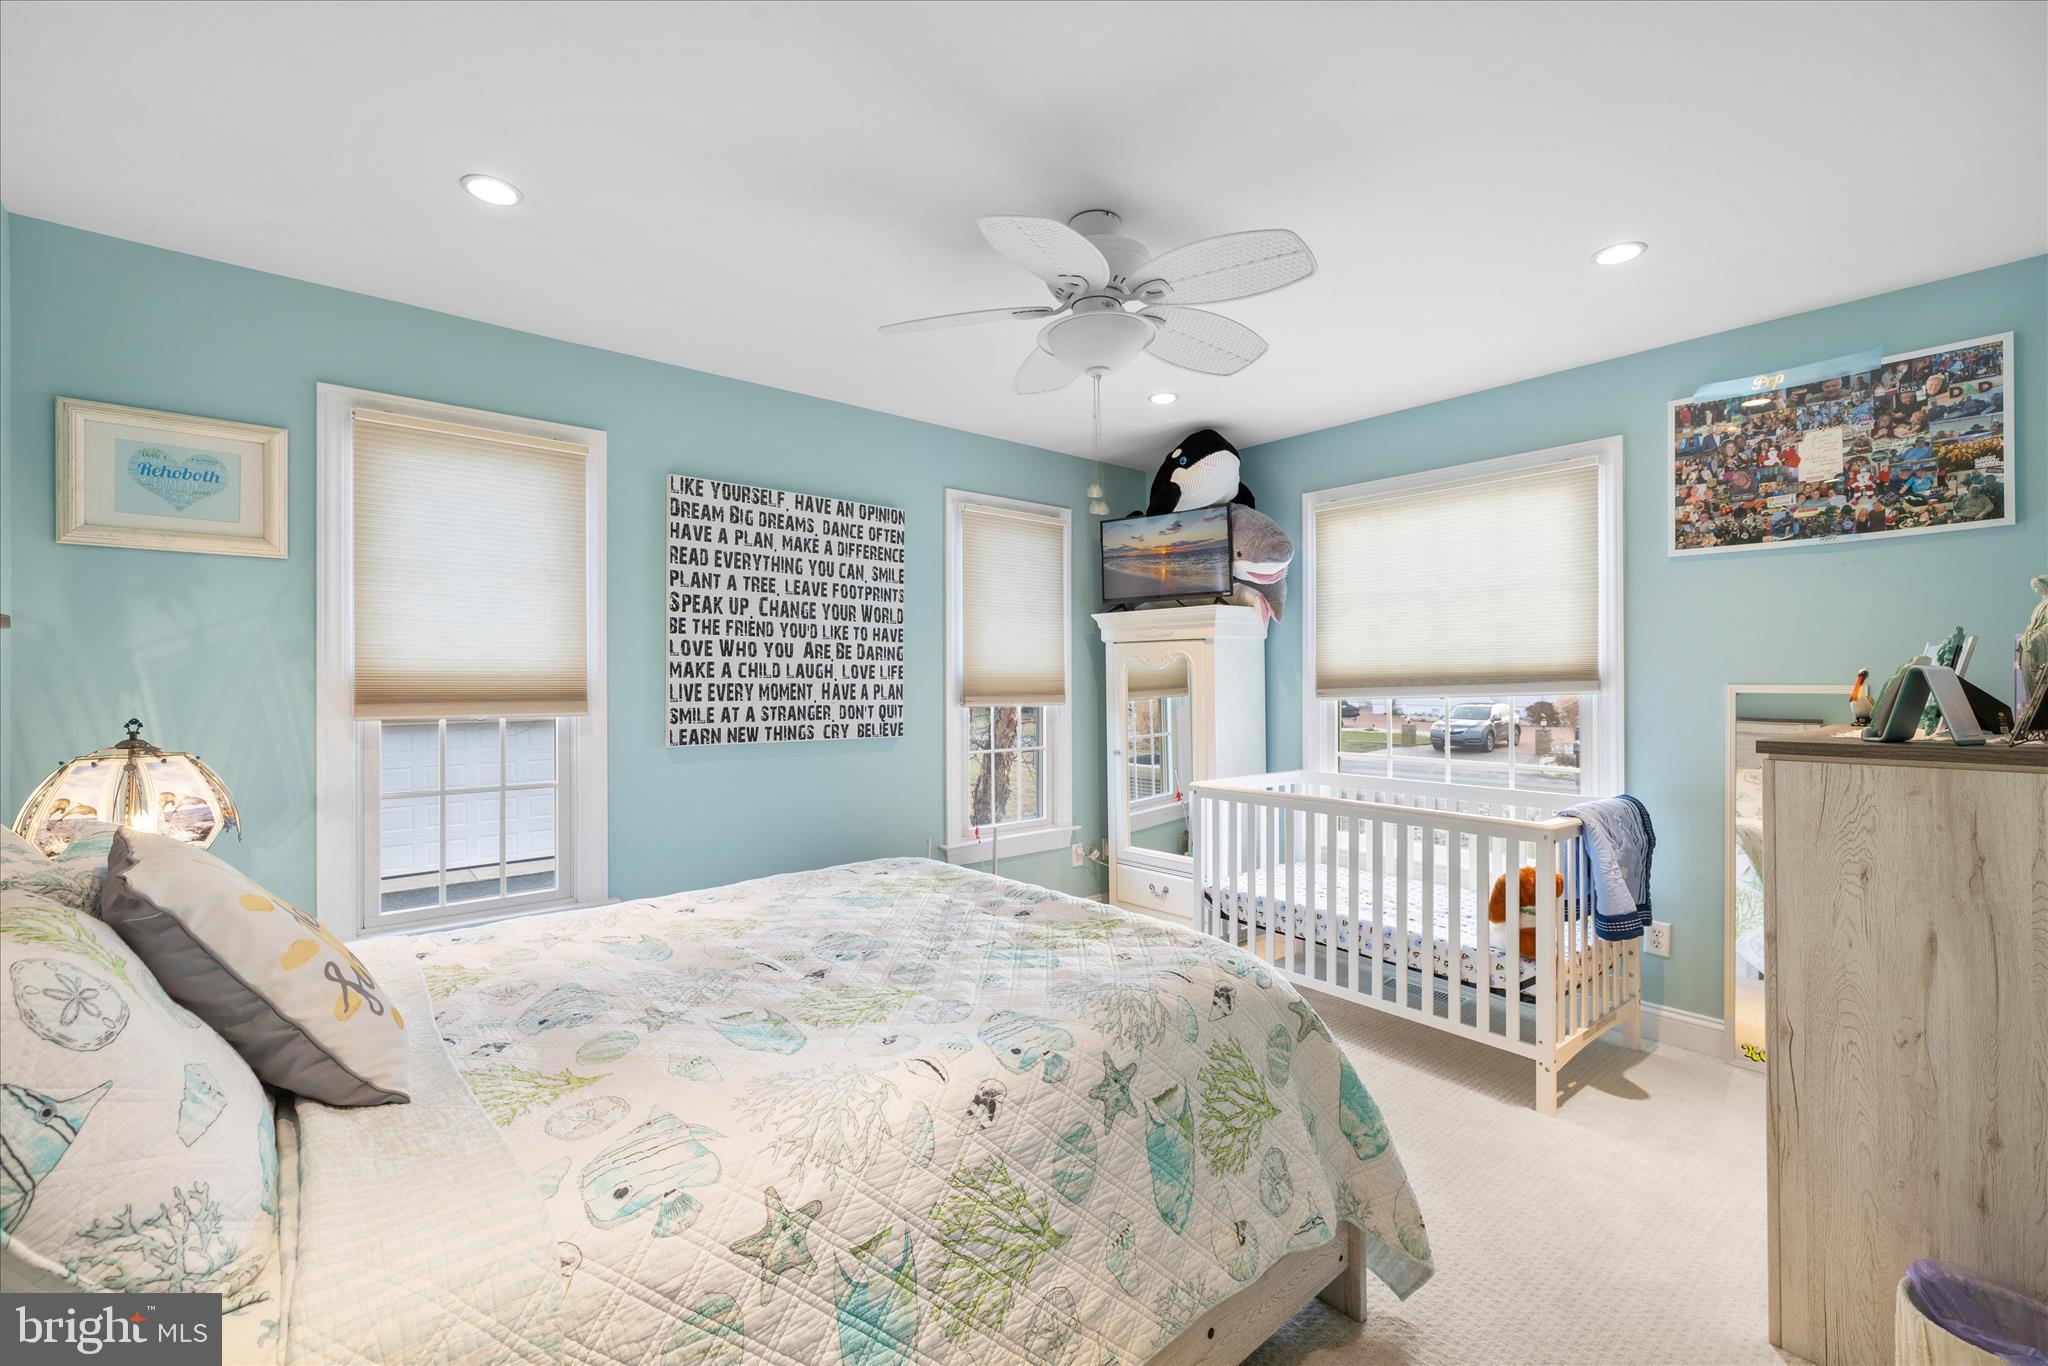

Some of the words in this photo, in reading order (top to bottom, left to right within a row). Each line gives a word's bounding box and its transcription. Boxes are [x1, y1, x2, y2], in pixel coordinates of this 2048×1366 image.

[1950, 381, 1993, 398] DAD
[138, 462, 220, 483] Rehoboth
[670, 476, 703, 496] LIKE
[795, 495, 831, 514] HAVE
[836, 501, 854, 518] AN
[859, 505, 905, 525] OPINION
[670, 497, 723, 522] DREAM
[730, 506, 753, 526] BIG
[823, 520, 863, 540] DANCE
[869, 527, 904, 544] OFTEN
[670, 522, 712, 542] HAVE
[718, 528, 728, 544] A
[782, 535, 819, 554] MAKE
[824, 541, 833, 555] A
[838, 542, 904, 563] DIFFERENCE
[670, 546, 708, 566] READ
[714, 550, 802, 575] EVERYTHING
[809, 560, 834, 578] YOU
[871, 568, 904, 584] SMILE
[670, 570, 721, 589] PLANT
[727, 575, 737, 591] A
[785, 580, 827, 597] LEAVE
[833, 583, 904, 603] FOOTPRINTS
[670, 592, 723, 614] SPEAK
[759, 597, 816, 619] CHANGE
[822, 603, 856, 622] YOUR
[861, 605, 903, 624] WORLD
[670, 617, 686, 634] BE
[693, 619, 720, 635] THE
[726, 620, 773, 637] FRIEND
[780, 623, 817, 639] YOU'D
[823, 625, 848, 640] LIKE
[853, 626, 867, 641] TO
[873, 628, 903, 642] HAVE
[670, 640, 712, 656] LOVE
[720, 640, 757, 657] WHO
[764, 642, 793, 658] YOU
[836, 643, 852, 660] BE
[857, 644, 903, 661] DARING
[670, 662, 714, 678] MAKE
[721, 663, 731, 678] A
[738, 663, 780, 678] CHILD
[842, 665, 875, 679] LOVE
[880, 666, 903, 679] LIFE
[670, 683, 702, 702] LIVE
[708, 683, 754, 701] EVERY
[822, 683, 856, 700] HAVE
[861, 684, 868, 700] A
[874, 684, 903, 700] PLAN
[670, 707, 714, 724] SMILE
[721, 707, 740, 723] AT
[746, 706, 755, 722] A
[839, 705, 874, 719] DON'T
[879, 705, 903, 721] QUIT
[670, 728, 721, 746] LEARN
[727, 727, 759, 743] NEW
[765, 725, 814, 741] THINGS
[824, 725, 849, 738] CRY
[858, 722, 903, 737] BELIEVE
